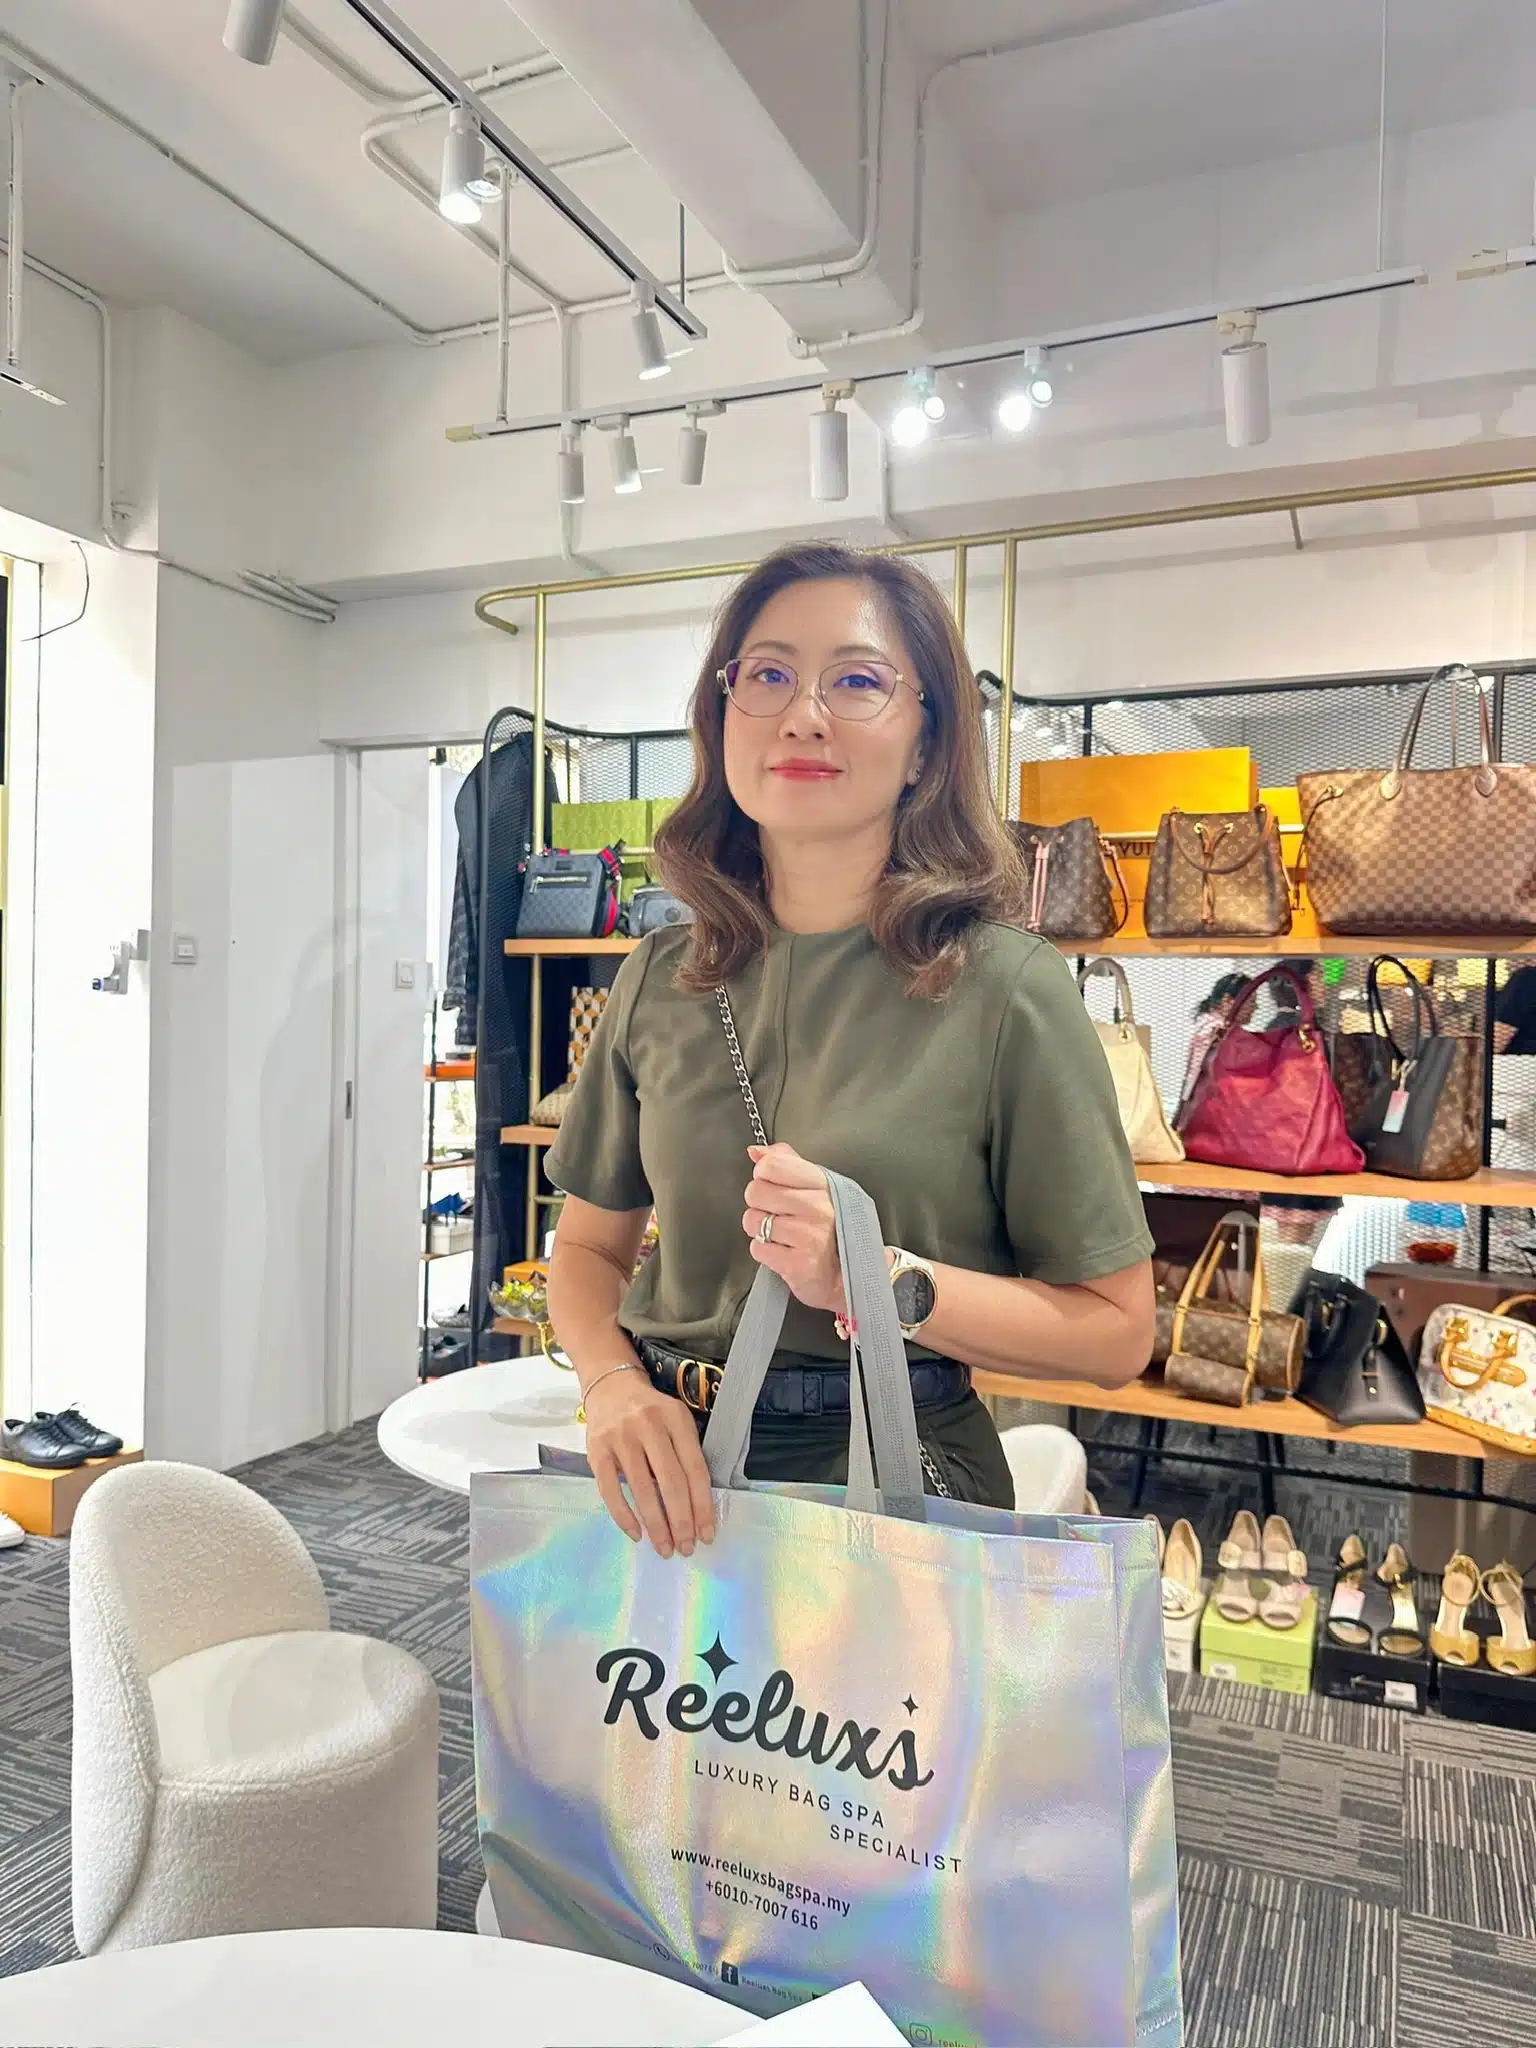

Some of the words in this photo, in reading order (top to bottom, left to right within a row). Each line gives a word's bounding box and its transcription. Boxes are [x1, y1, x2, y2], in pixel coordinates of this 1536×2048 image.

[695, 1760, 778, 1795] LUXURY
[789, 1785, 831, 1811] BAG
[842, 1802, 885, 1829] SPA
[830, 1825, 962, 1873] SPECIALIST
[671, 1849, 850, 1917] www.reeluxsbagspa.my
[705, 1881, 788, 1920] +6010-7007
[791, 1909, 819, 1931] 616
